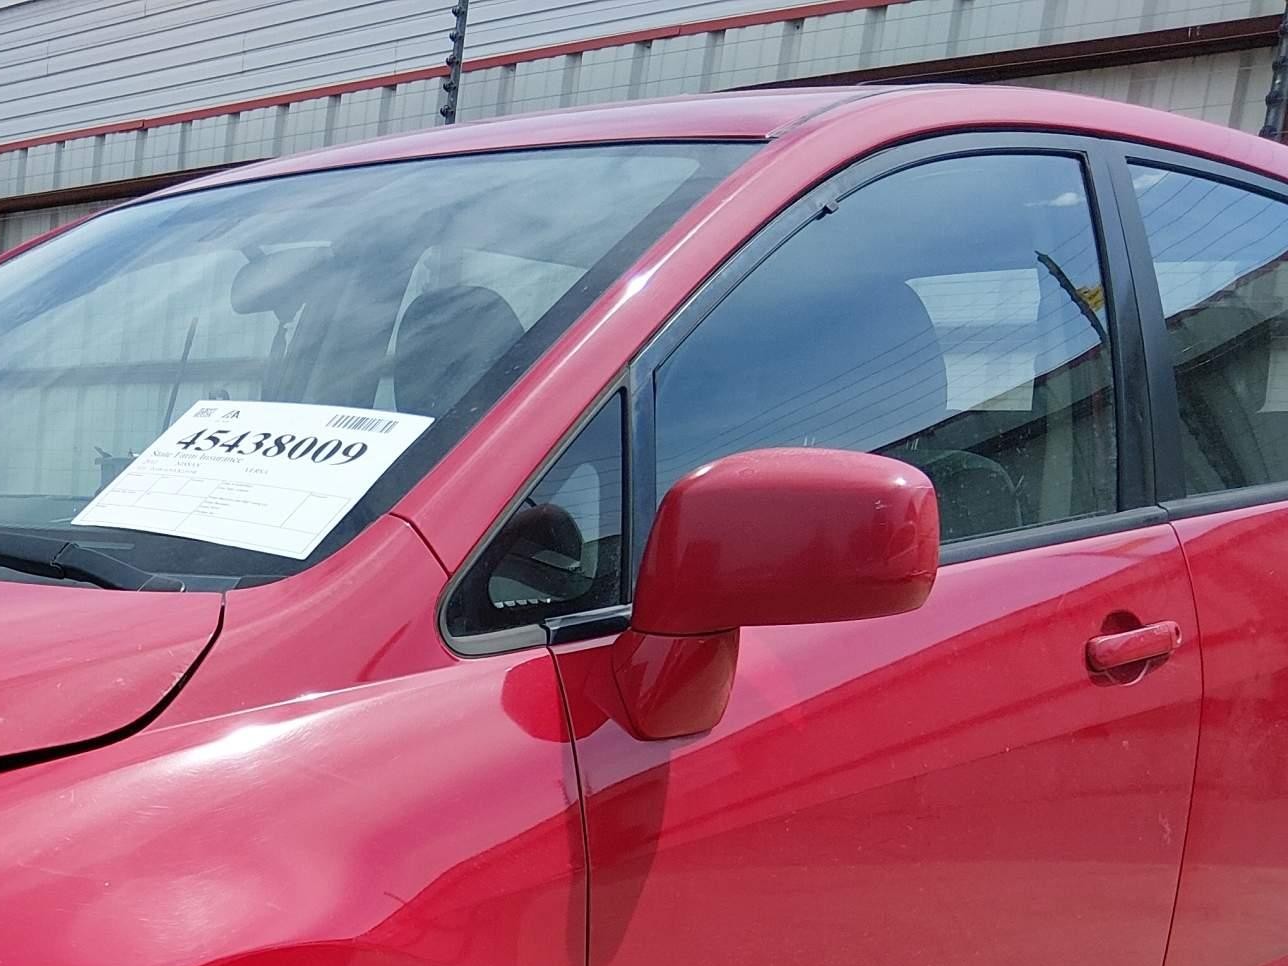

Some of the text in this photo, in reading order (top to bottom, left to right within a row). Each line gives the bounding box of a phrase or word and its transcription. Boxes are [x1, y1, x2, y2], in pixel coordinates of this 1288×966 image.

[173, 451, 199, 462] Farm
[199, 451, 244, 465] Insurance
[176, 428, 368, 466] 45438009
